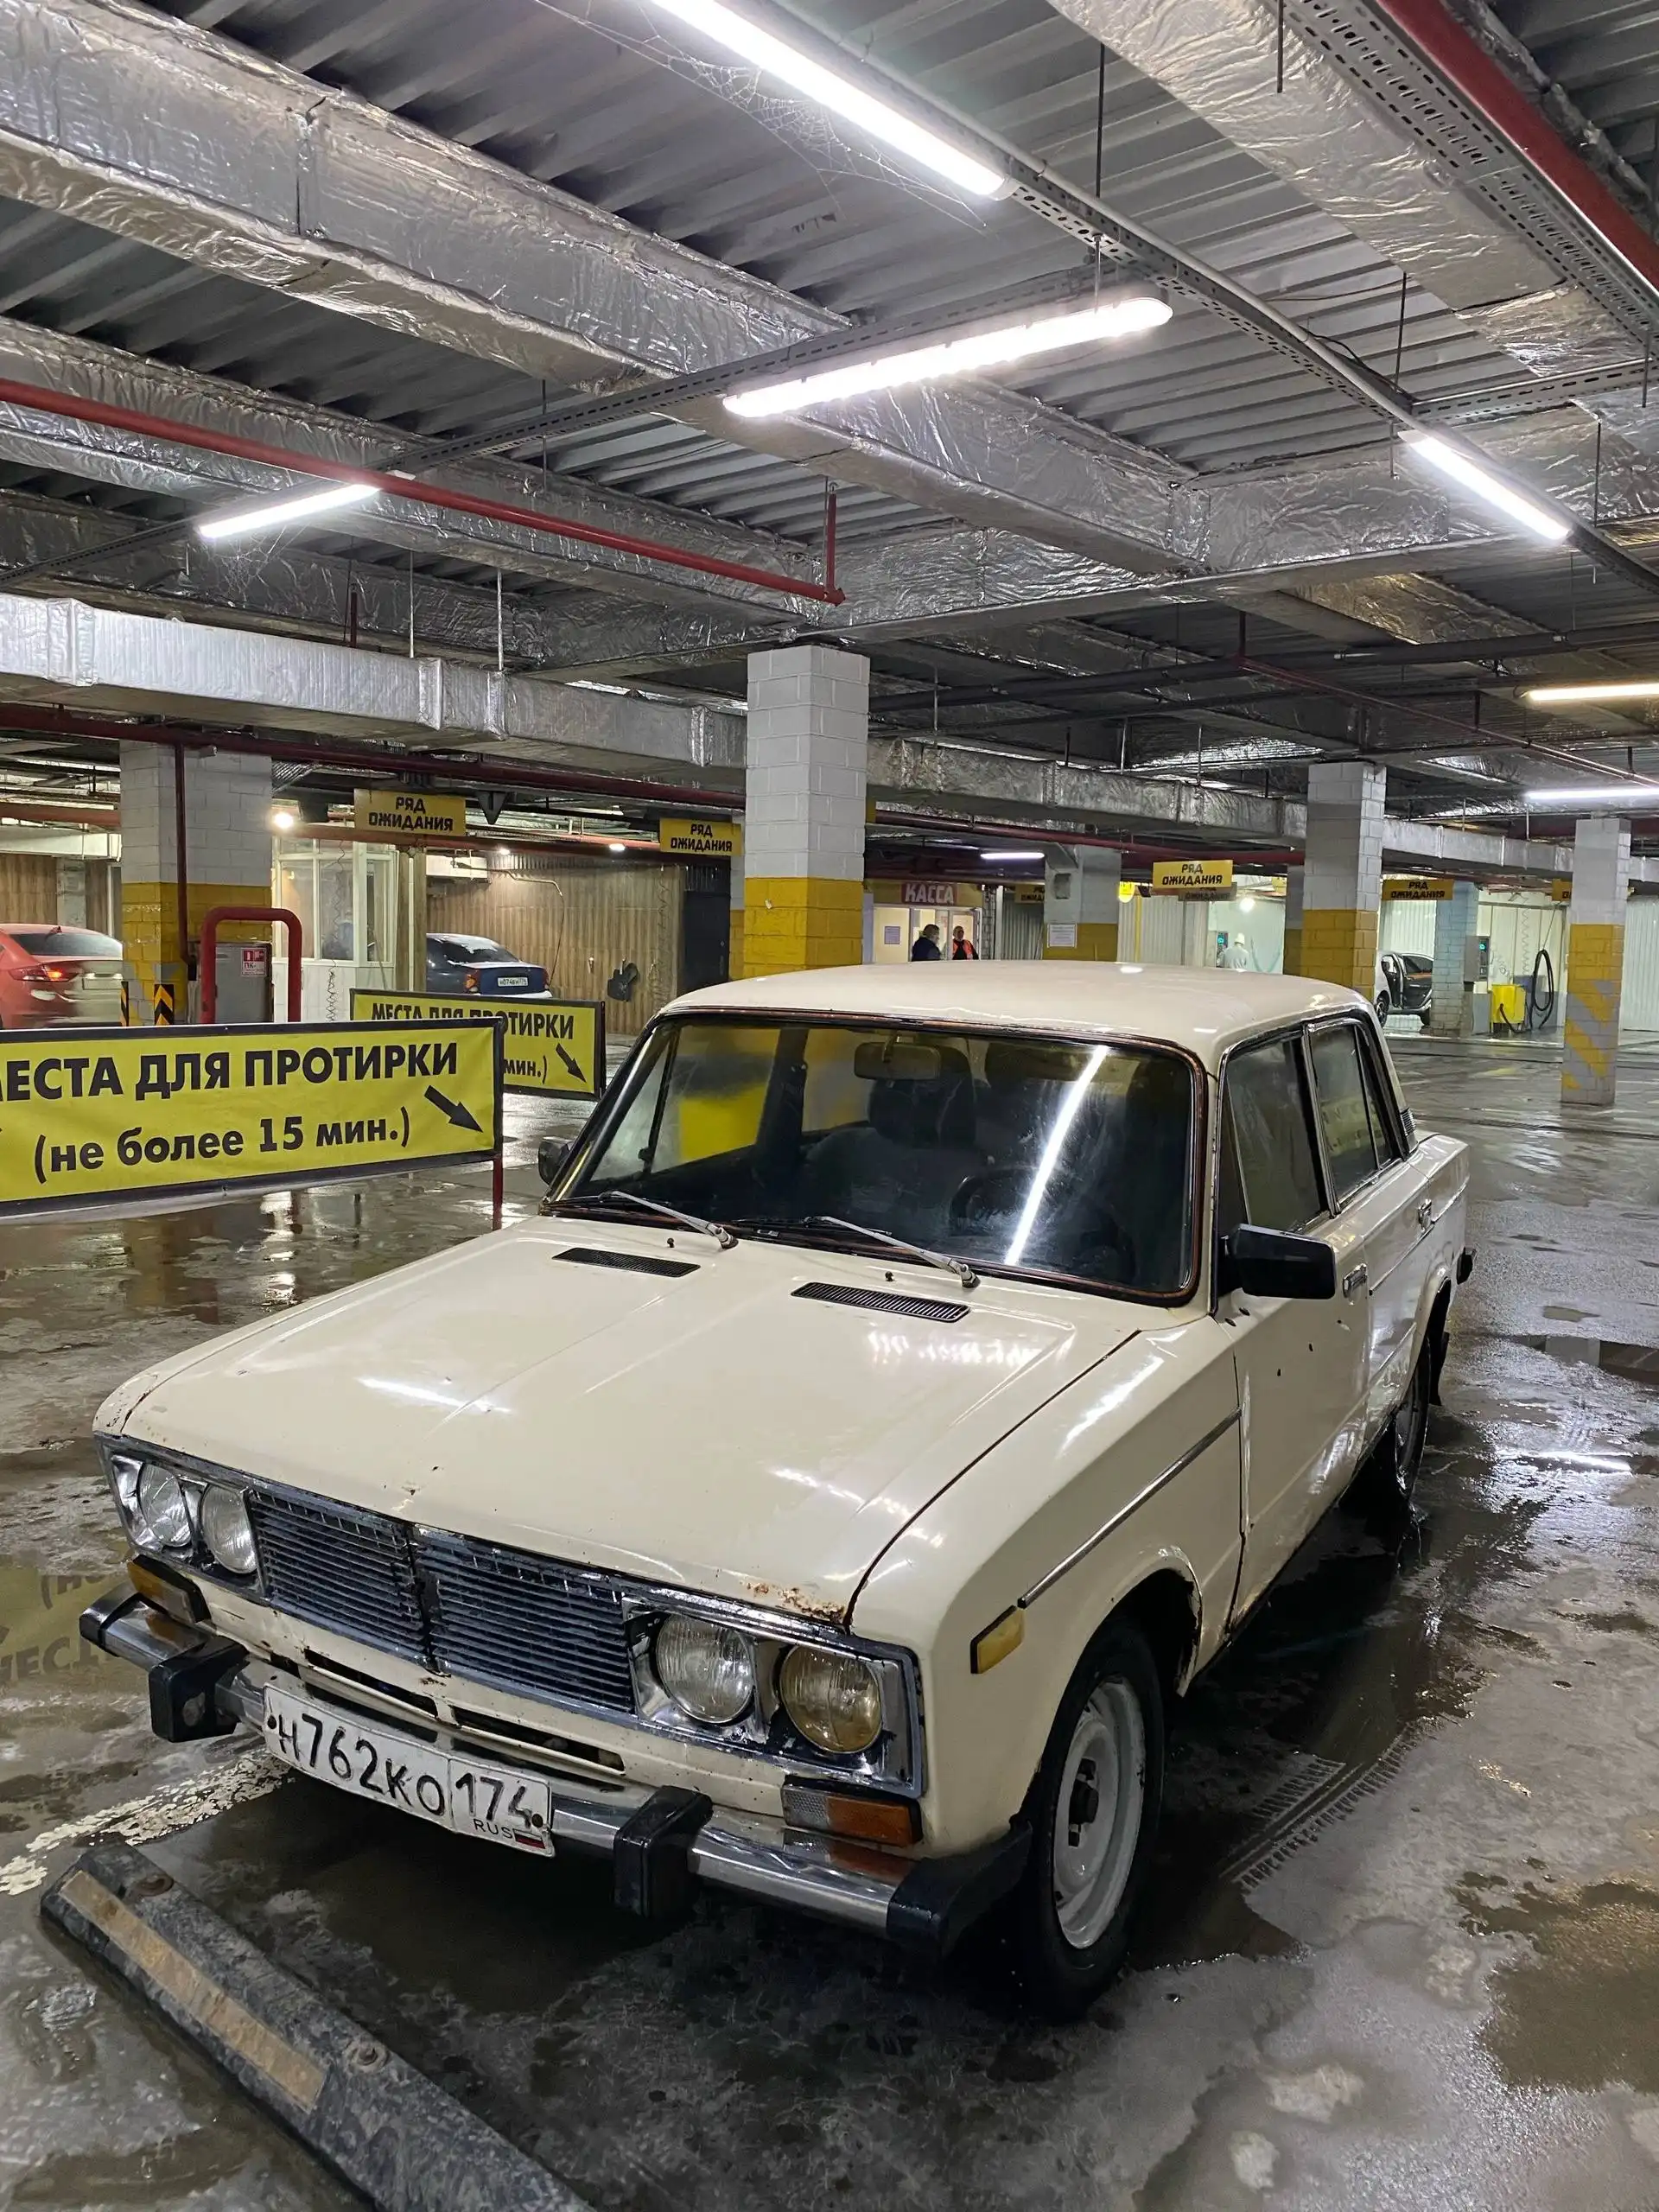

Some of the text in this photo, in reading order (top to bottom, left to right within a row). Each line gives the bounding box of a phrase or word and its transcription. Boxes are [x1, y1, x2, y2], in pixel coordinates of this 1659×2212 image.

[396, 797, 426, 814] РЯД
[368, 812, 454, 831] ОЖИДАНИЯ
[690, 823, 713, 837] РЯД
[671, 837, 733, 852] ОЖИДАНИЯ
[1181, 864, 1204, 874] РЯД
[1162, 874, 1223, 887] ОЖИДАНИЯ
[1408, 881, 1428, 890] РЯД
[905, 883, 954, 904] КАССА
[1390, 890, 1446, 899] ОЖИДАНИЯ
[0, 1042, 457, 1102] ЕСТА ДЛЯ ПРОТИРКИ
[35, 1105, 410, 1185] (не более 15 мин.)
[474, 1819, 512, 1839] RUS
